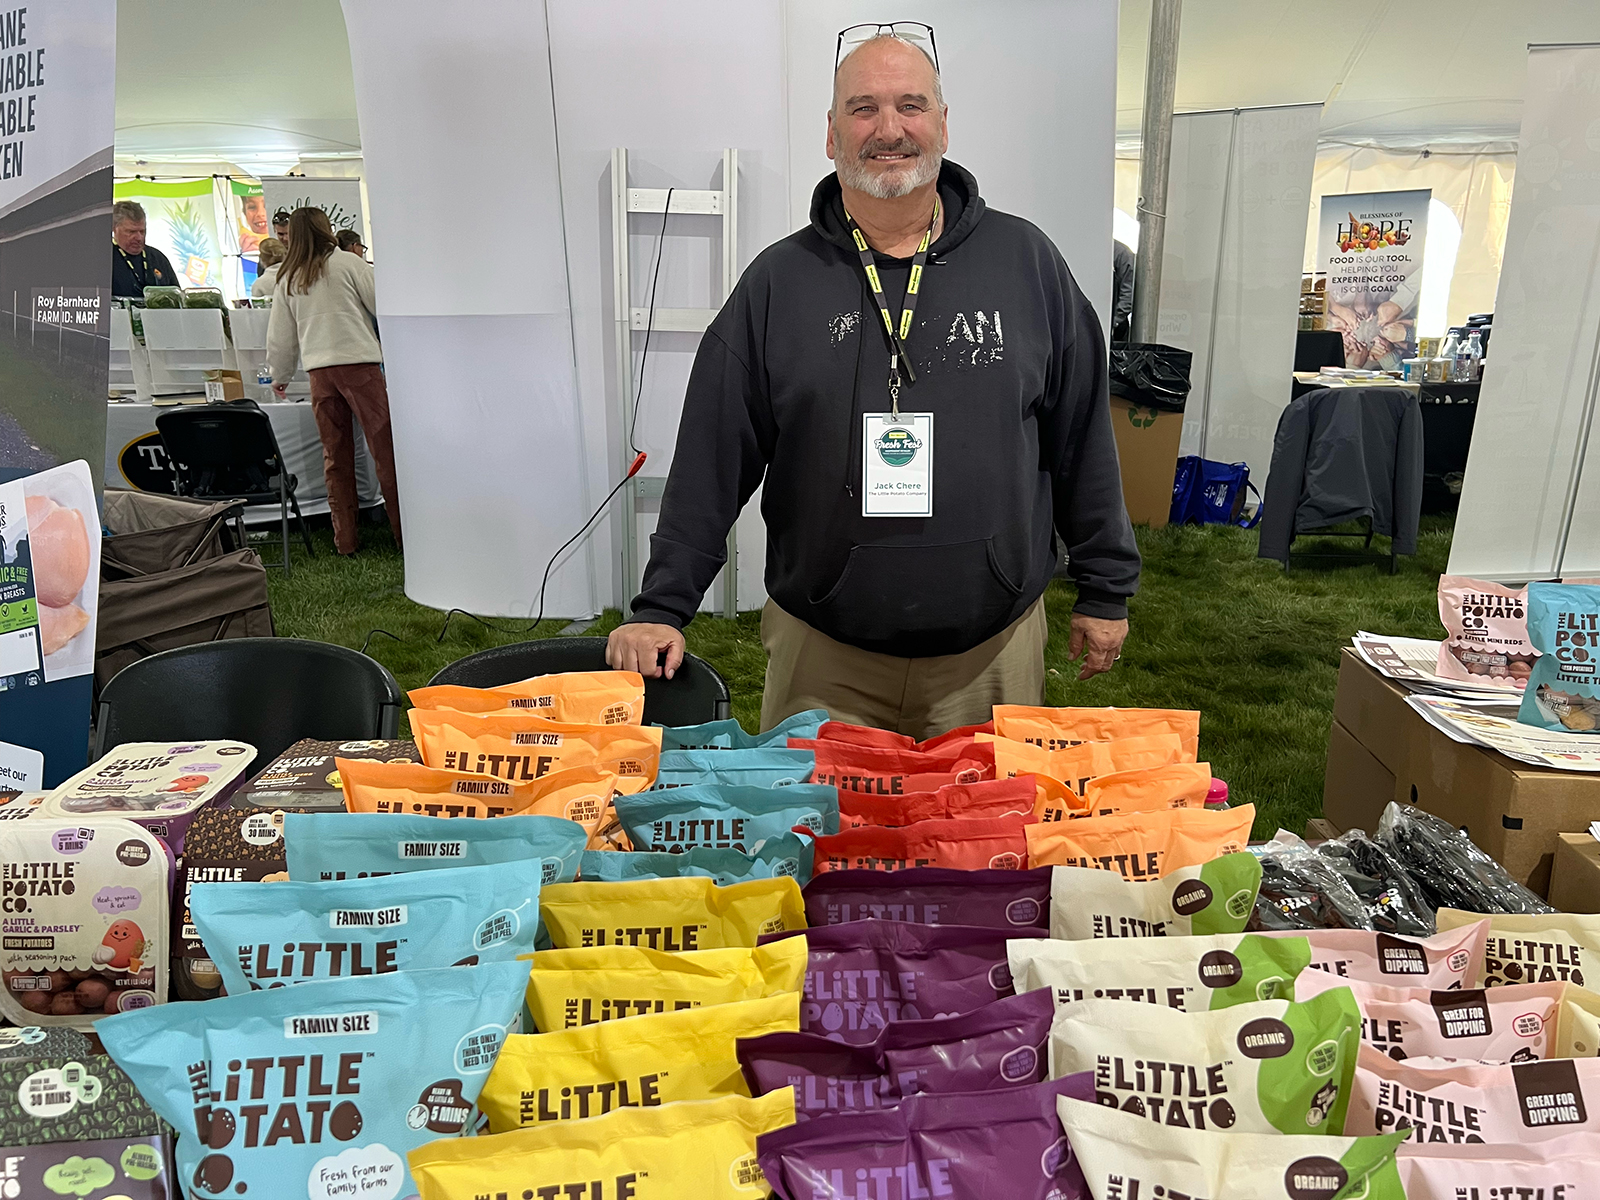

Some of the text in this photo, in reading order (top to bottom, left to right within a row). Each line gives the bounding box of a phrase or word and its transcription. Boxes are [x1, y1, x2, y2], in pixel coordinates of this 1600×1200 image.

[1337, 219, 1412, 243] HOPE
[1332, 276, 1384, 284] EXPERIENCE
[1350, 285, 1369, 293] OUR
[37, 295, 100, 309] Roy Barnhard
[37, 311, 99, 324] FARM ID: NARF
[874, 438, 923, 449] Fresh Fest
[17, 568, 28, 576] FREE
[3, 588, 25, 599] BREASTS
[1462, 606, 1524, 619] POTATO
[1462, 618, 1488, 628] CO.
[1558, 612, 1566, 629] THE
[1465, 635, 1485, 643] LITTLE
[1556, 648, 1596, 662] CO.
[1557, 673, 1589, 684] LITTLE
[511, 696, 552, 708] FAMILY SIZE
[516, 733, 559, 745] FAMILY SIZE
[13, 771, 27, 781] our
[456, 781, 510, 795] FAMILY SIZE
[574, 801, 595, 810] THE ONLY
[248, 829, 276, 837] 30 MINS
[653, 822, 663, 842] THE
[59, 842, 63, 850] 5
[404, 842, 460, 857] FAMILY SIZE
[3, 880, 75, 896] POTATO
[1176, 888, 1206, 907] ORGANIC
[2, 897, 32, 913] CO.
[336, 908, 401, 926] FAMILY SIZE
[494, 915, 506, 926] ONLY
[3, 925, 32, 933] GARLIC
[41, 925, 80, 933] PARSLEY
[480, 927, 494, 938] THING
[4, 938, 52, 948] FRESH POTATOES
[480, 928, 512, 945] NEED PEEL
[1383, 948, 1407, 959] GREAT
[1486, 937, 1495, 957] THE
[7, 953, 77, 965] with seasoning pack
[1385, 958, 1424, 973] DIPPING
[1202, 964, 1234, 977] ORGANIC
[1485, 957, 1585, 987] POTATO
[565, 998, 578, 1028] THE
[1442, 1007, 1484, 1020] GREAT FOR
[292, 1014, 371, 1035] FAMILY SIZE
[1446, 1020, 1486, 1036] DIPPING
[468, 1034, 497, 1047] THE ONLY
[1244, 1032, 1286, 1048] ORGANIC
[462, 1047, 478, 1058] THING
[463, 1056, 489, 1068] NEED TO
[1097, 1055, 1110, 1087] THE
[45, 1091, 71, 1105] MINS
[1379, 1080, 1390, 1106] THE
[1526, 1093, 1576, 1108] GREAT FOR
[430, 1106, 469, 1123] 5 MINS
[520, 1089, 535, 1128] THE
[1530, 1106, 1579, 1124] DIPPING
[320, 1162, 394, 1183] Fresh from our
[326, 1176, 388, 1197] family farms
[1293, 1174, 1339, 1191] ORGANIC
